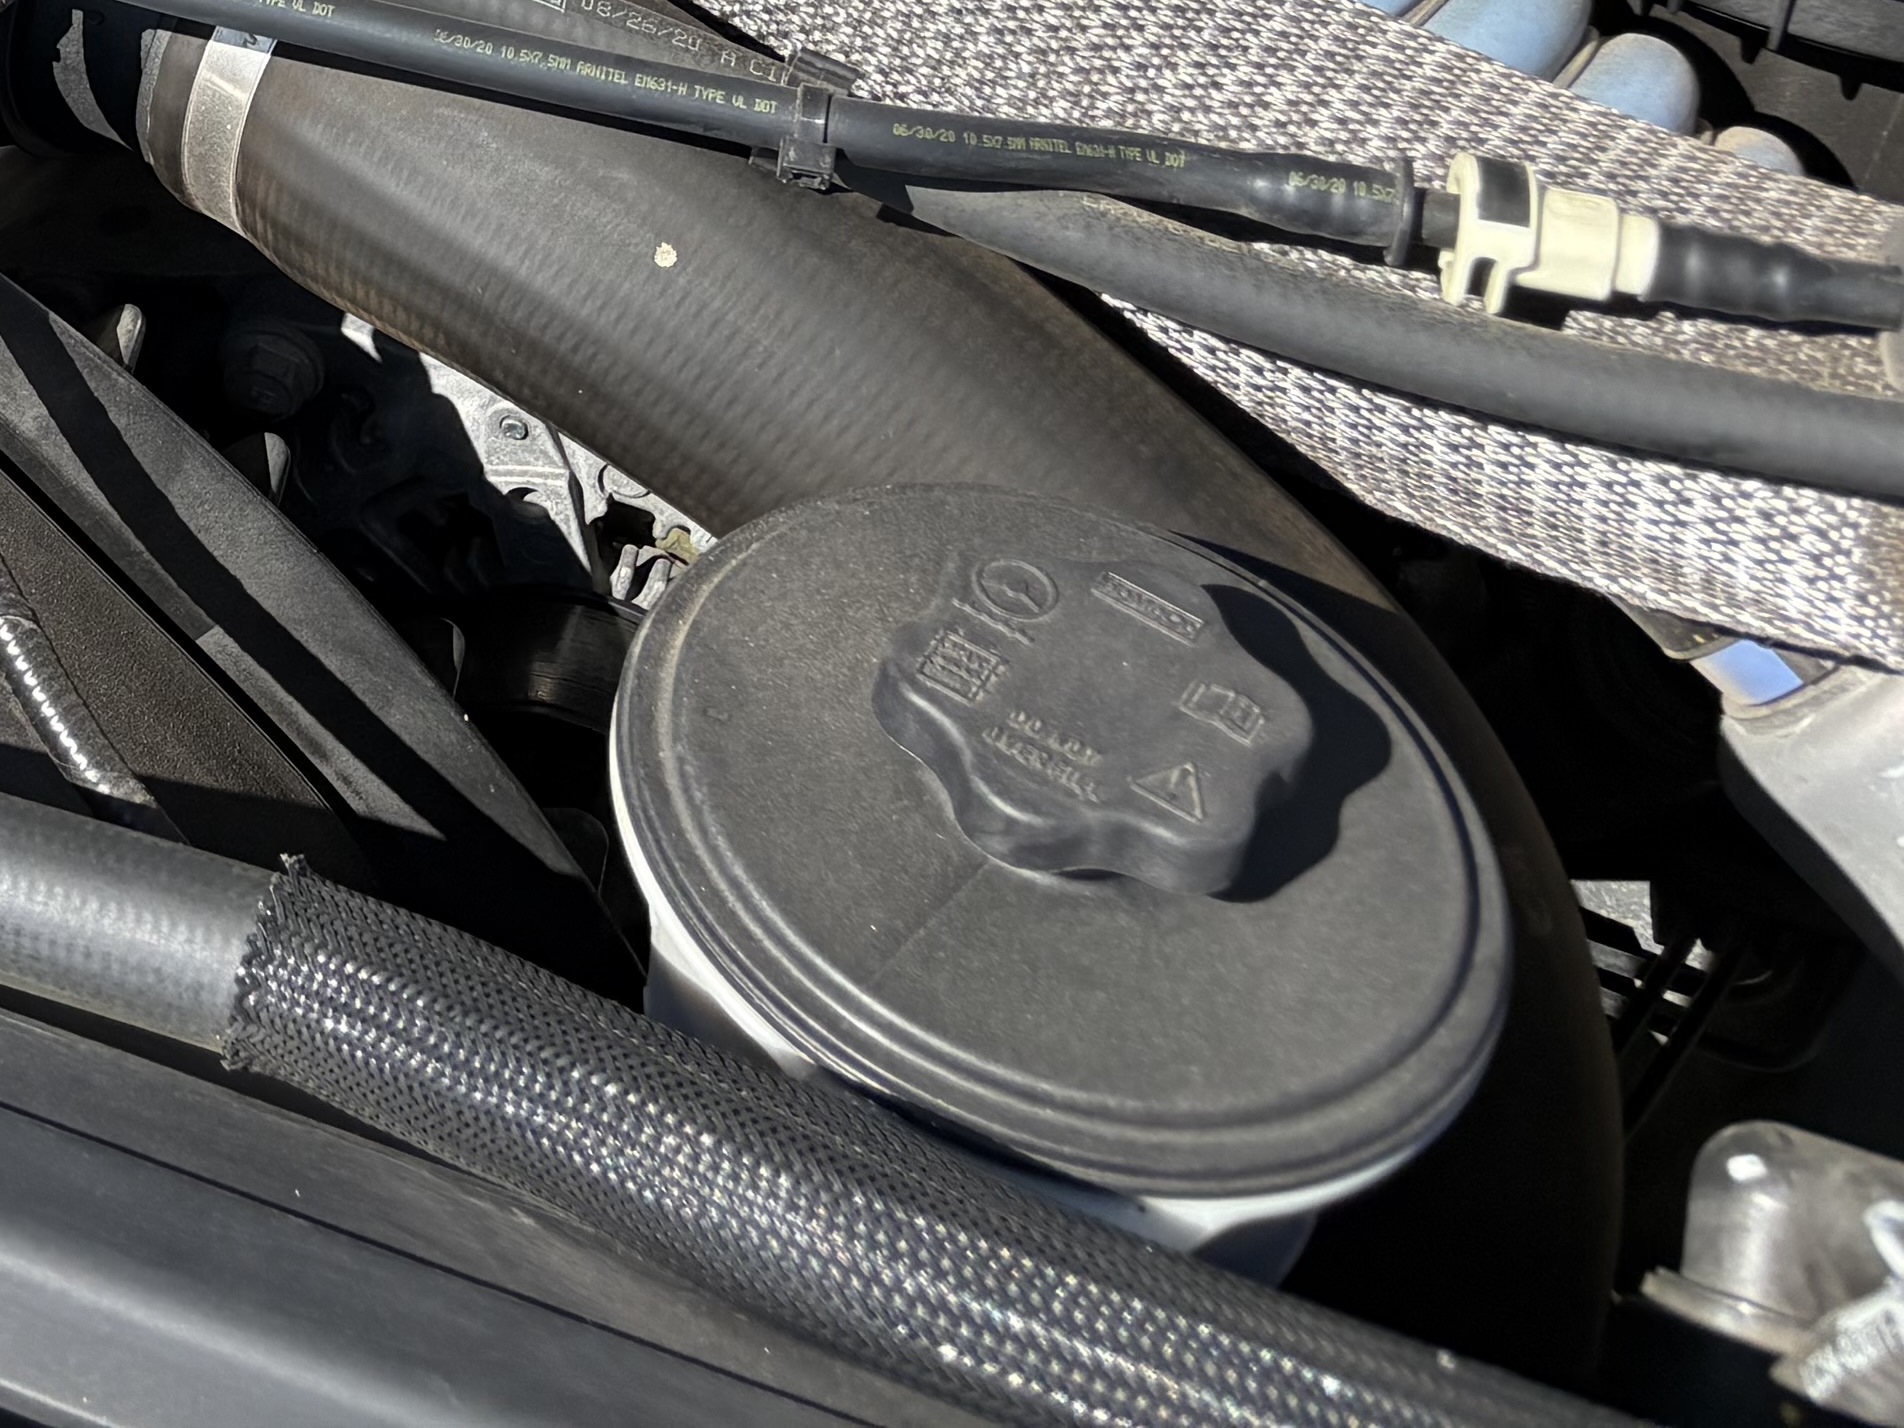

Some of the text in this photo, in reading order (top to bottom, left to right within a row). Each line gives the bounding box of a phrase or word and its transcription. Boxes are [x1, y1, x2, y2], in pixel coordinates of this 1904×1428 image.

[311, 1, 335, 18] DOT
[693, 84, 726, 104] TYPE
[752, 97, 778, 114] DOT
[891, 122, 957, 143] 06/30/20
